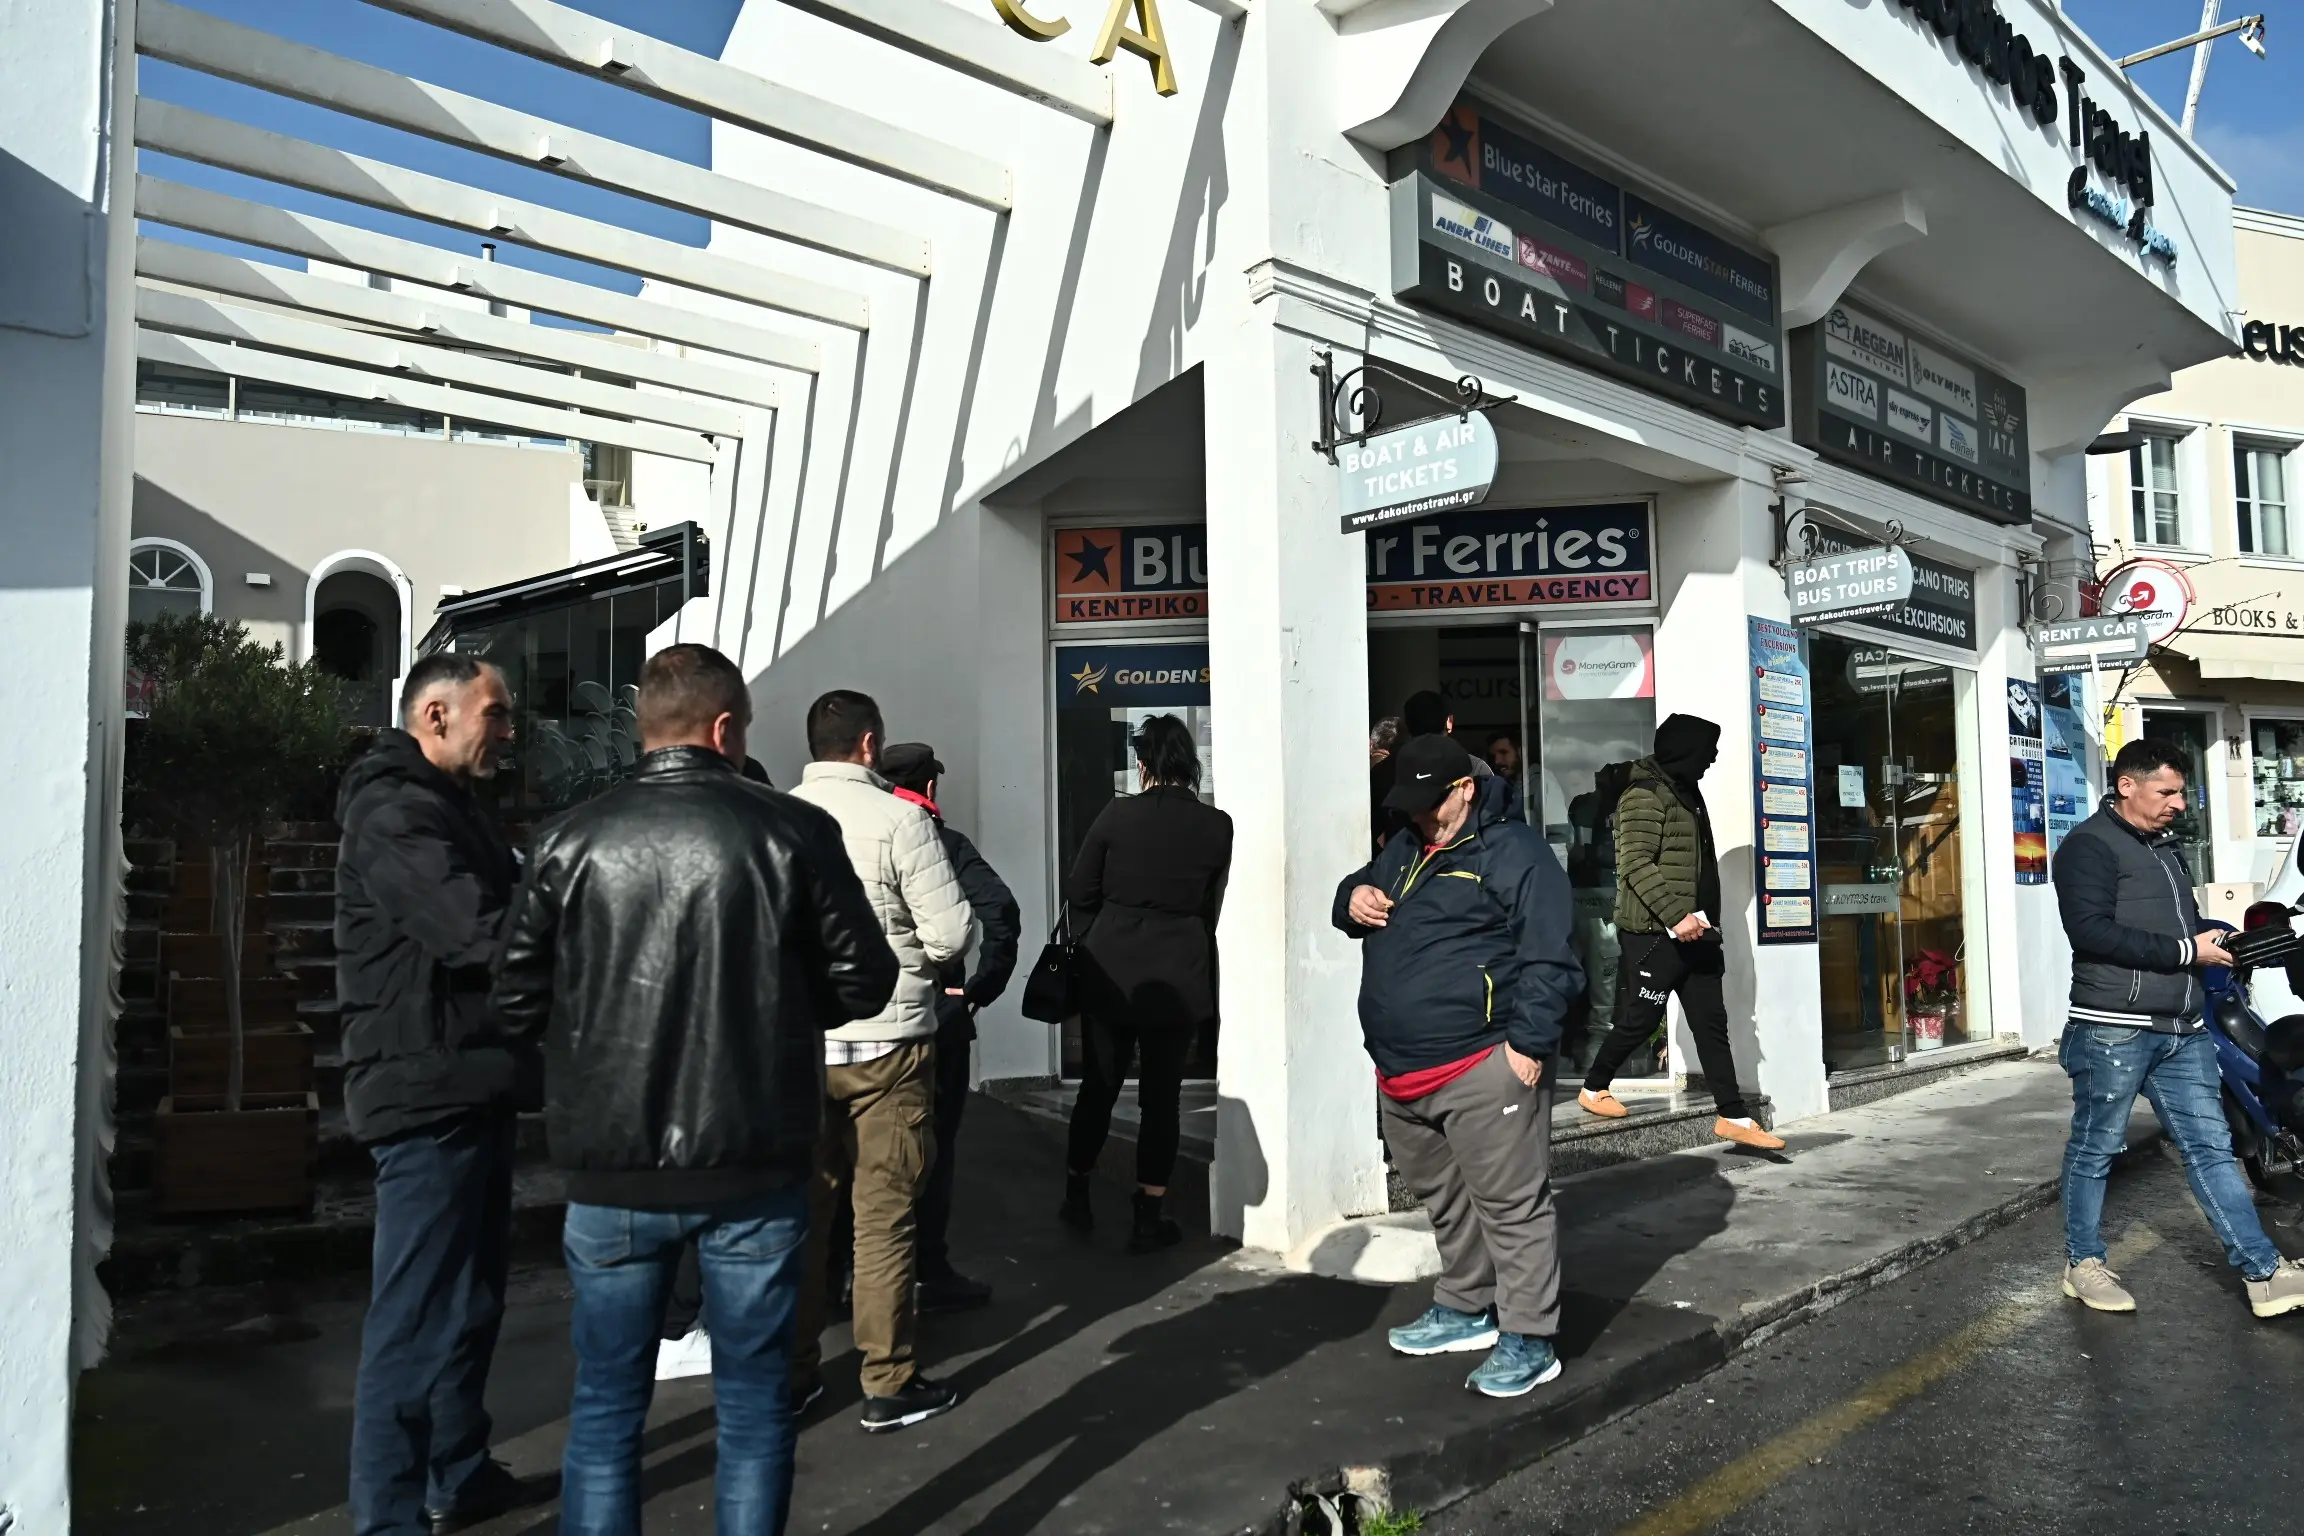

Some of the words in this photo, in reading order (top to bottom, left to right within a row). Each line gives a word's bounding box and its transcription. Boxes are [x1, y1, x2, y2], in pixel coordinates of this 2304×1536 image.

[1484, 142, 1523, 184] Blue
[1526, 163, 1558, 200] Star
[1561, 183, 1613, 229] Ferries
[1436, 216, 1473, 241] ANEK
[1475, 234, 1511, 257] LINES
[1539, 251, 1571, 271] ZANTE
[1677, 307, 1718, 331] SUPERFAST
[1682, 322, 1712, 341] FERRIES
[1447, 260, 1569, 333] BOAT
[1607, 326, 1770, 413] TICKETS
[1853, 323, 1905, 366] AEGEAN
[2241, 319, 2304, 364] eus
[1728, 343, 1771, 370] SEAJETS
[1828, 366, 1876, 409] ASTRA
[1922, 366, 1972, 402] OLYMPIC
[1346, 441, 1406, 475] BOAT
[1414, 435, 1430, 458] &
[1436, 423, 1477, 453] AIR
[1988, 427, 2016, 459] IATA
[1364, 458, 1458, 498] TICKETS
[1848, 427, 1893, 464] AIR
[1915, 453, 2014, 512] TICKETS
[1352, 489, 1475, 526] www.dakoutrostravel.gr
[1794, 563, 1841, 586] BOAT
[1845, 553, 1899, 576] TRIPS
[1912, 566, 1940, 591] CANO
[1941, 575, 1970, 600] TRIPS
[1411, 583, 1517, 606] TRAVEL
[1528, 577, 1640, 601] AGENCY
[1796, 586, 1832, 607] BUS
[1836, 576, 1898, 601] TOURS
[1798, 602, 1895, 624] www.dakoutrostravel.gr
[1904, 606, 1966, 639] EXCURSIONS
[2212, 607, 2277, 629] BOOKS
[2285, 611, 2298, 630] &
[2039, 627, 2082, 643] RENT
[2086, 626, 2099, 638] A
[2102, 622, 2138, 637] CAR
[1114, 669, 1197, 686] GOLDEN
[2043, 660, 2133, 673] www.dakoutrtravel.gr
